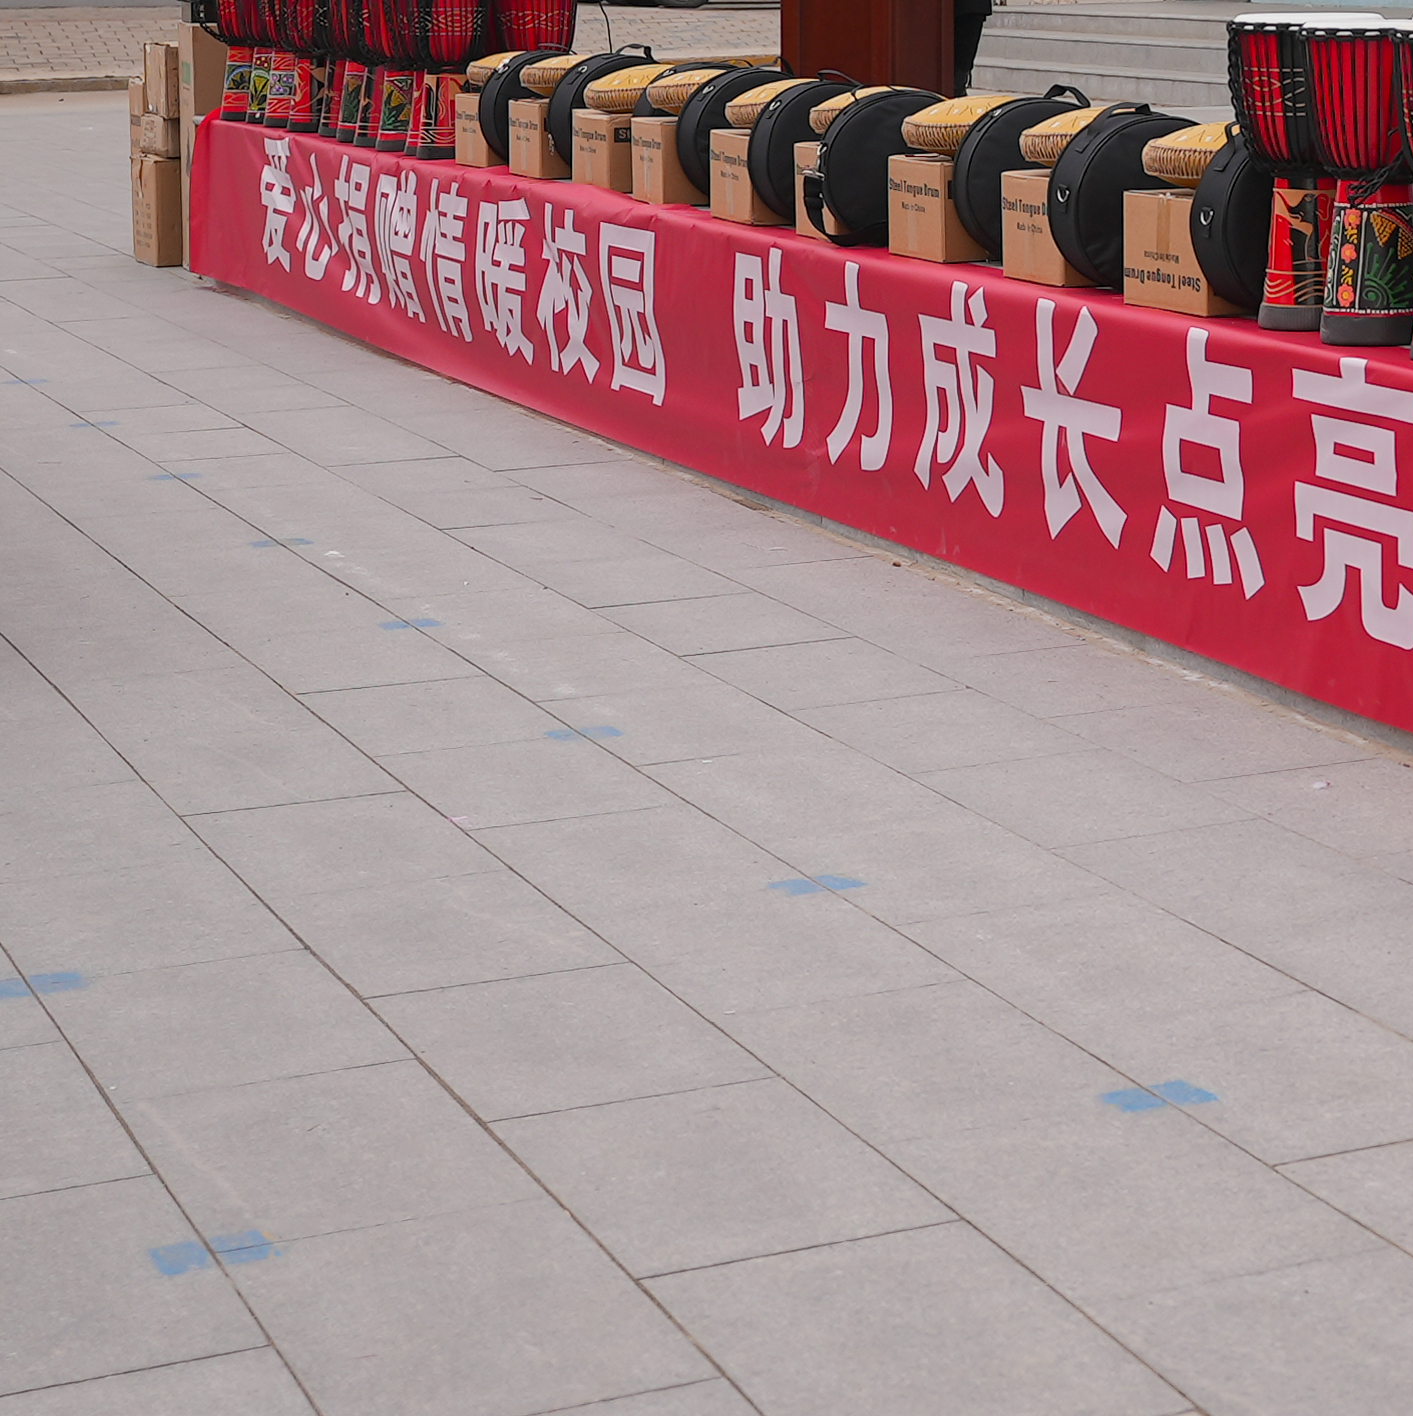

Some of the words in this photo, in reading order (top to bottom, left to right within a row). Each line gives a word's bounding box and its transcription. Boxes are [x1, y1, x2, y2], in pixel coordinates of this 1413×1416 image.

[260, 136, 667, 407] 爱心捐赠情暖校园
[1177, 274, 1202, 293] Steel
